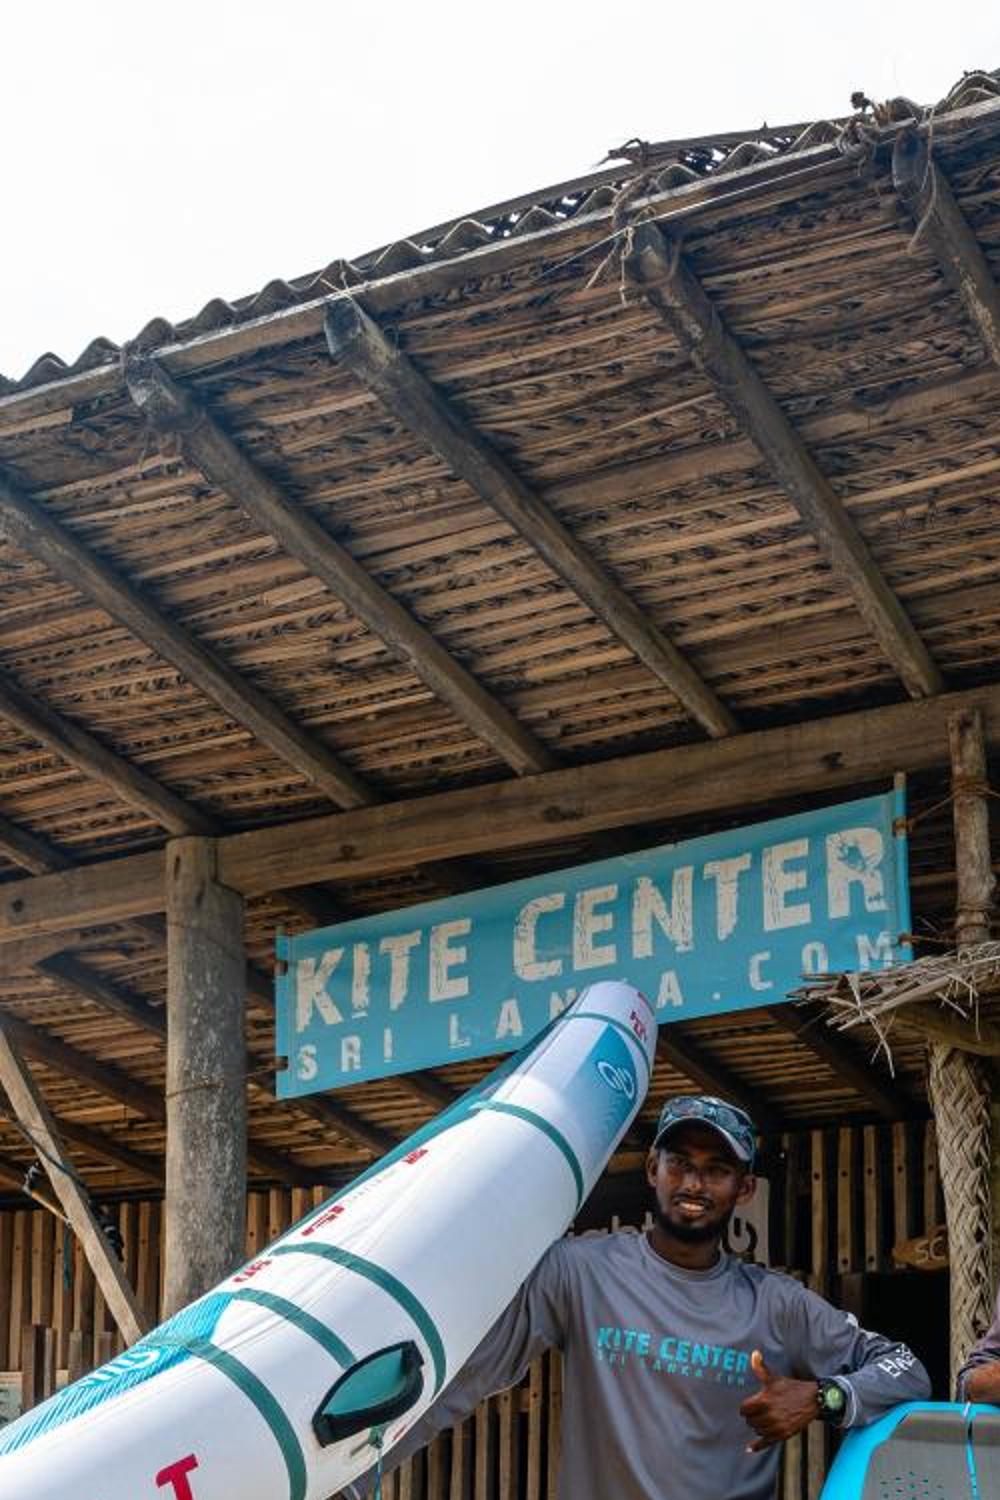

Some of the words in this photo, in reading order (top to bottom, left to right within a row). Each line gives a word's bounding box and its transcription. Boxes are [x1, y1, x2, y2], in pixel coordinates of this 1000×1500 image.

[295, 919, 471, 1033] KITE
[513, 826, 889, 981] CENTER
[297, 1027, 394, 1081] SRI
[450, 930, 896, 1049] LANA.COM
[598, 1327, 650, 1355] KITE
[660, 1336, 748, 1373] CENTER
